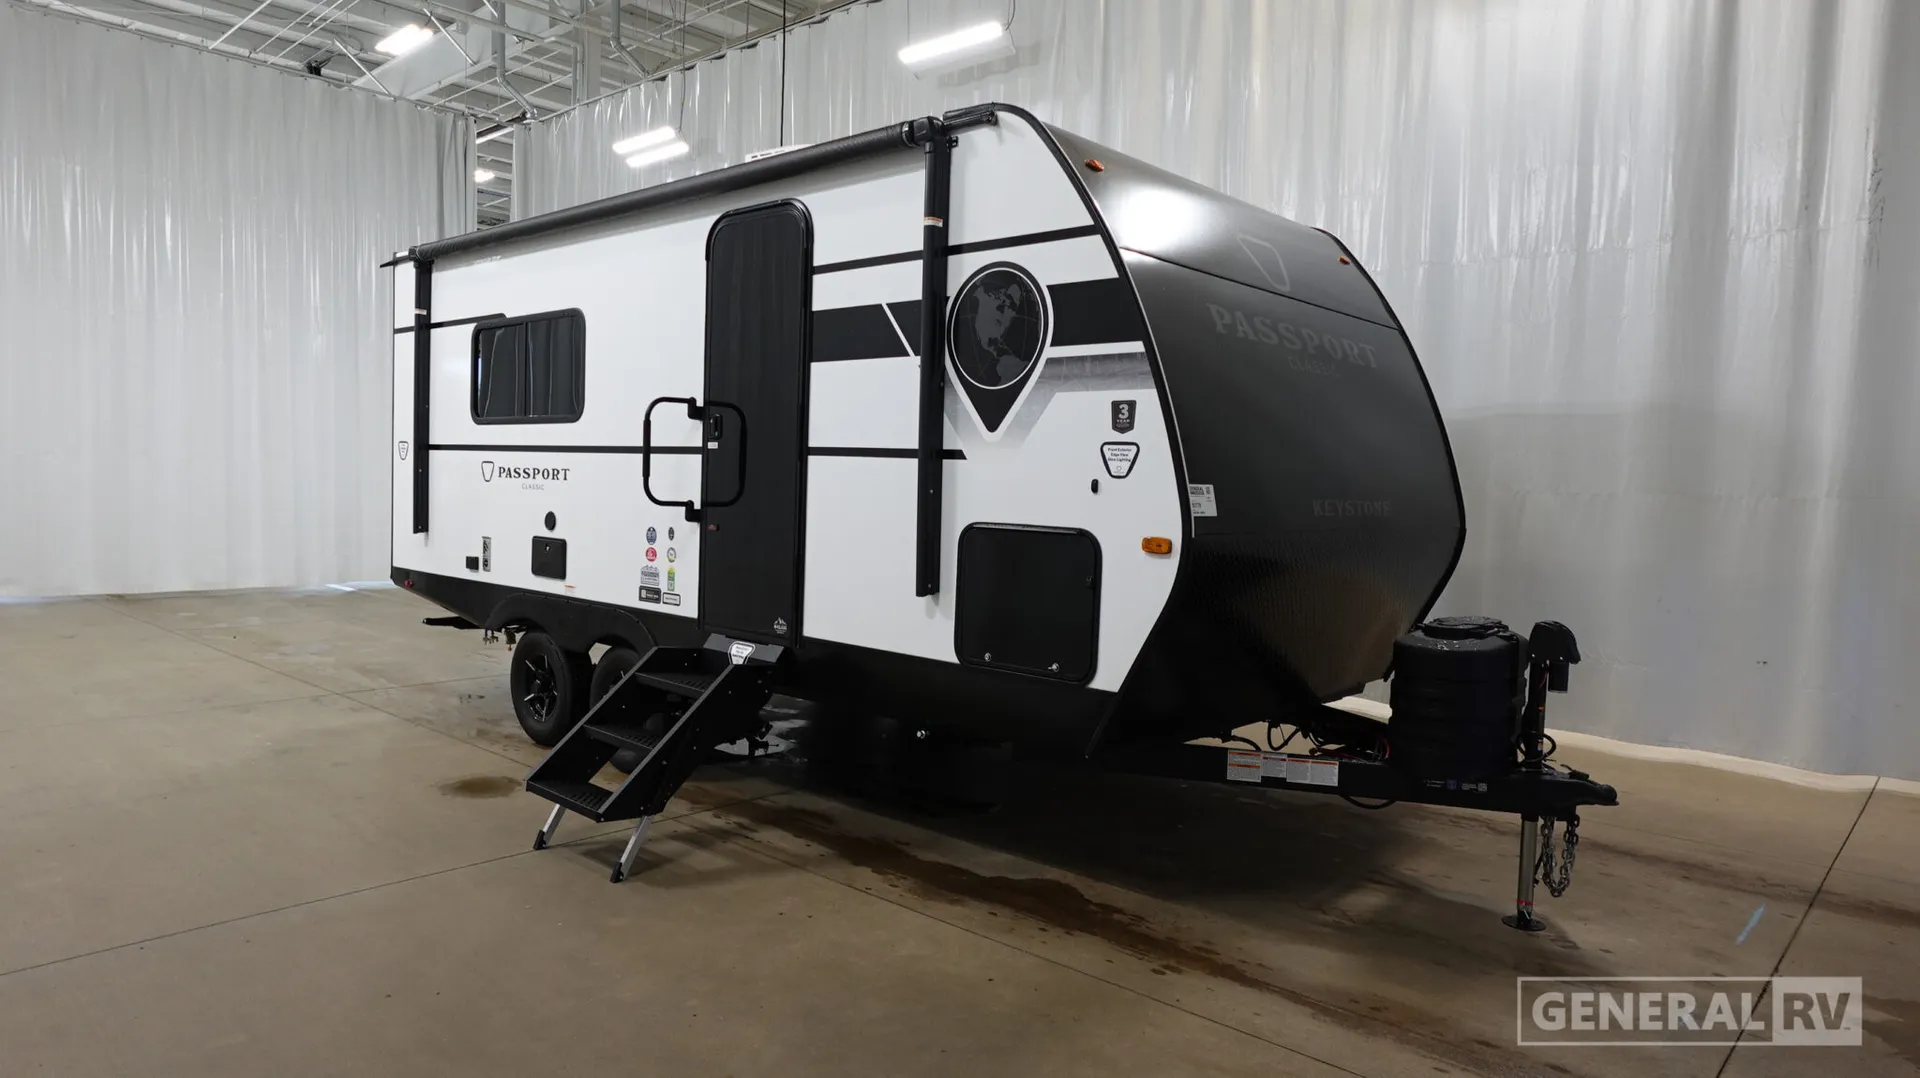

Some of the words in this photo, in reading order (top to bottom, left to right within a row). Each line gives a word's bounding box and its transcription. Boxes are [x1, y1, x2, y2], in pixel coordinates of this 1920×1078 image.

[1206, 302, 1377, 369] PASSPORT
[1118, 403, 1129, 419] 3
[498, 466, 570, 481] PASSPORT
[522, 483, 545, 491] CLASSIC
[1312, 498, 1391, 518] KEYSTONE
